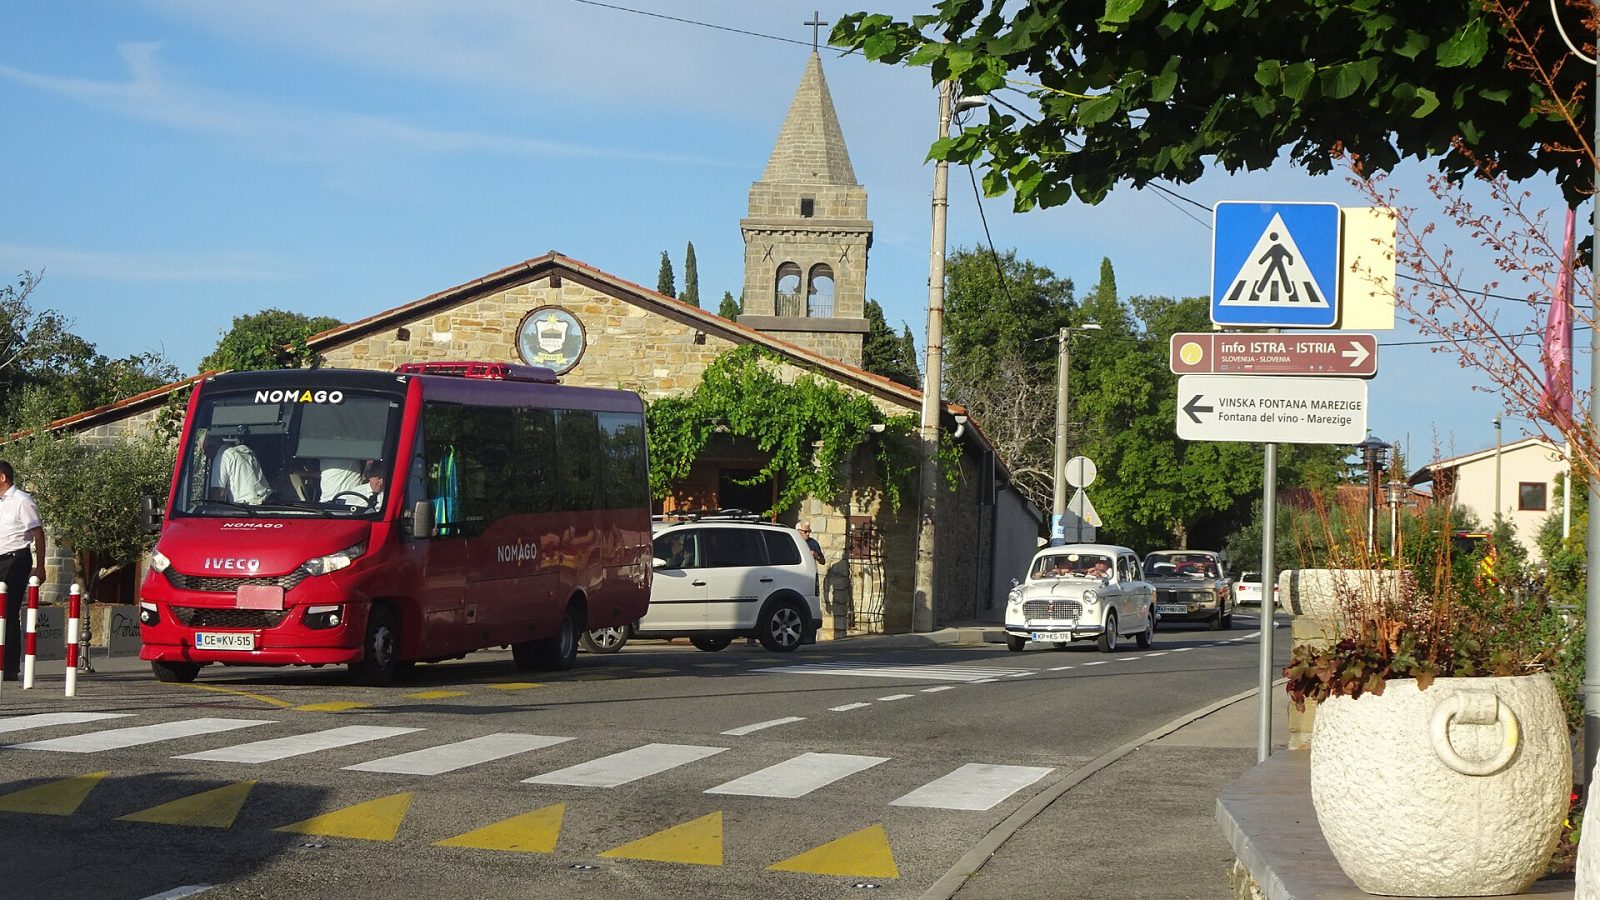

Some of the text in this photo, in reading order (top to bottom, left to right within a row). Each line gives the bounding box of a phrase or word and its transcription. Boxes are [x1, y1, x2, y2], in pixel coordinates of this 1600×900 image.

[1221, 341, 1246, 353] info
[1250, 342, 1286, 353] ISTRA
[1296, 342, 1336, 354] ISTRIA
[1259, 355, 1291, 363] SLOVENIA
[254, 389, 344, 404] NOMAGO
[1218, 397, 1362, 411] VINSKA FONTANA MAREZIGE
[1218, 411, 1257, 422] Fontana
[1260, 412, 1275, 423] del
[1277, 412, 1299, 423] vino
[1307, 414, 1352, 427] Marezige
[497, 543, 537, 563] NOMAGO
[204, 557, 260, 572] IVECO
[204, 635, 251, 646] CE KV-515
